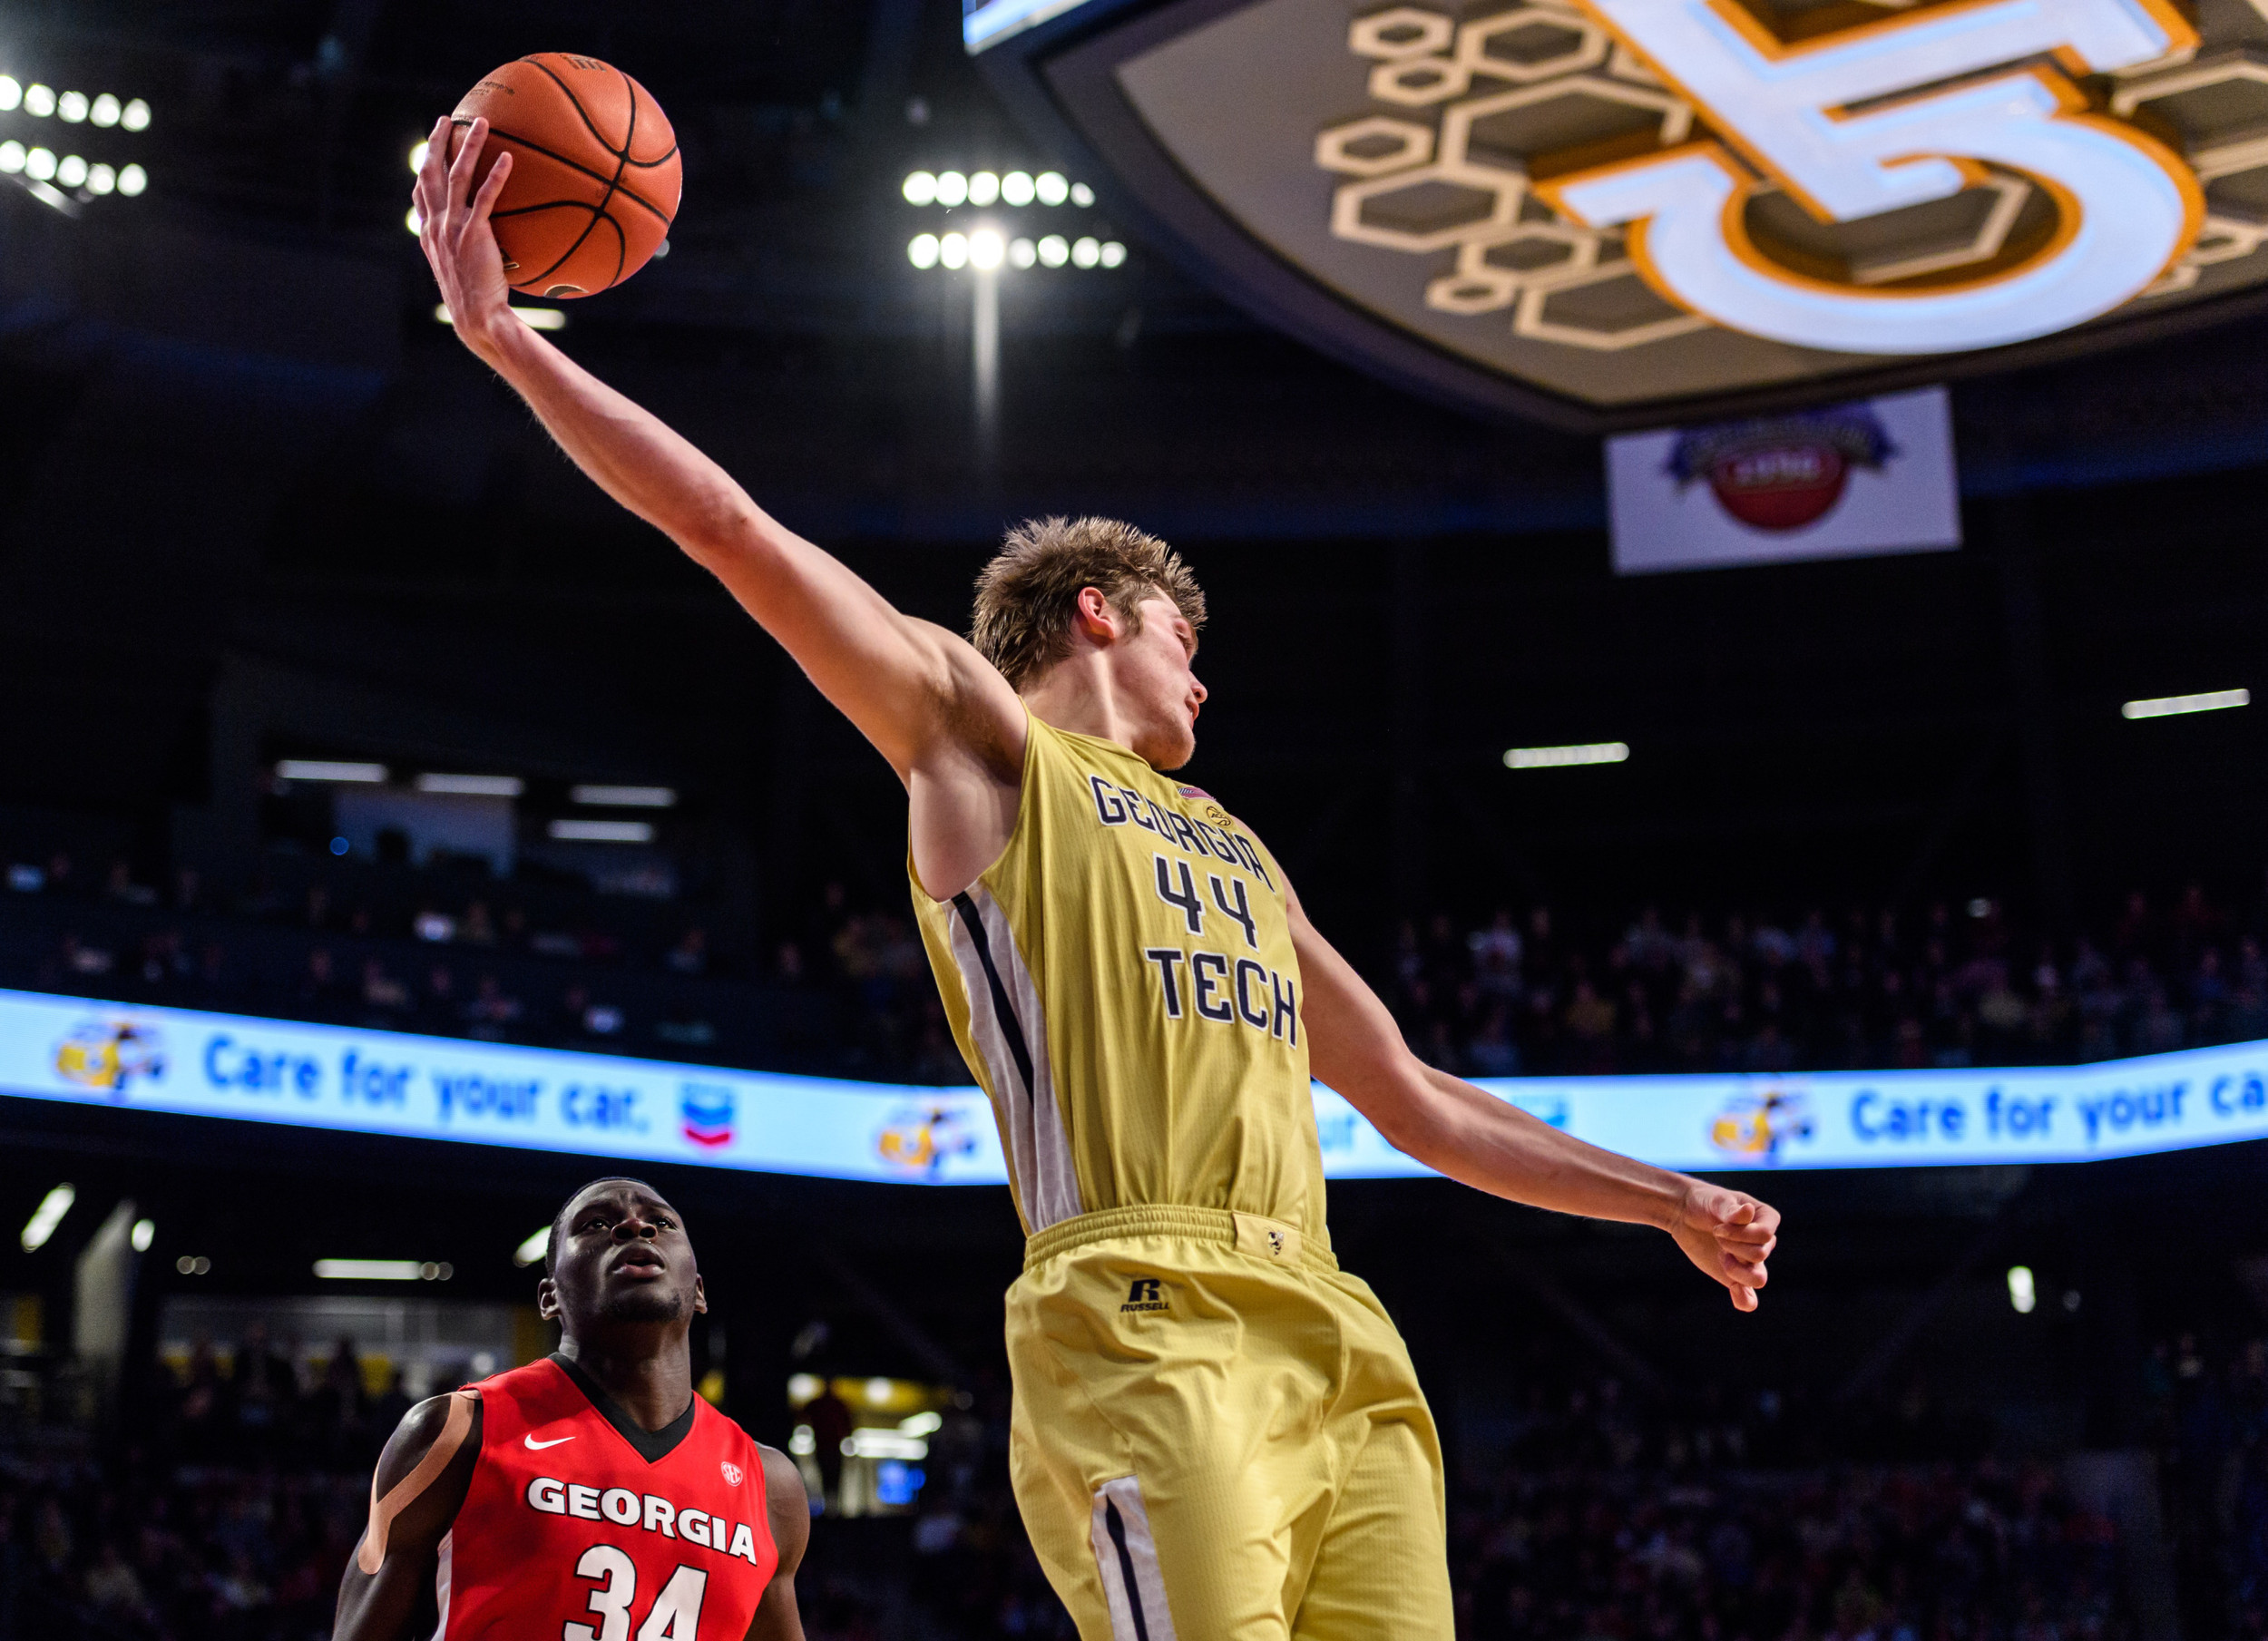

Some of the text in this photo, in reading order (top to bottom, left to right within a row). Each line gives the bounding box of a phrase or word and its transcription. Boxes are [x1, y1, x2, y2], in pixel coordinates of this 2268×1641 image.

[1090, 775, 1276, 894] GEORGIA
[1152, 852, 1259, 952] 44
[1144, 947, 1297, 1050] TECH
[201, 1033, 321, 1103] Care
[341, 1047, 413, 1110] for
[432, 1070, 542, 1128] your
[1850, 1089, 1966, 1144] Care
[1987, 1086, 2058, 1139] for
[2077, 1081, 2191, 1148] your
[1120, 1302, 1169, 1313] RUSSELL
[723, 1463, 741, 1484] SEC
[528, 1476, 757, 1567] GEORGIA
[562, 1544, 709, 1641] 34
